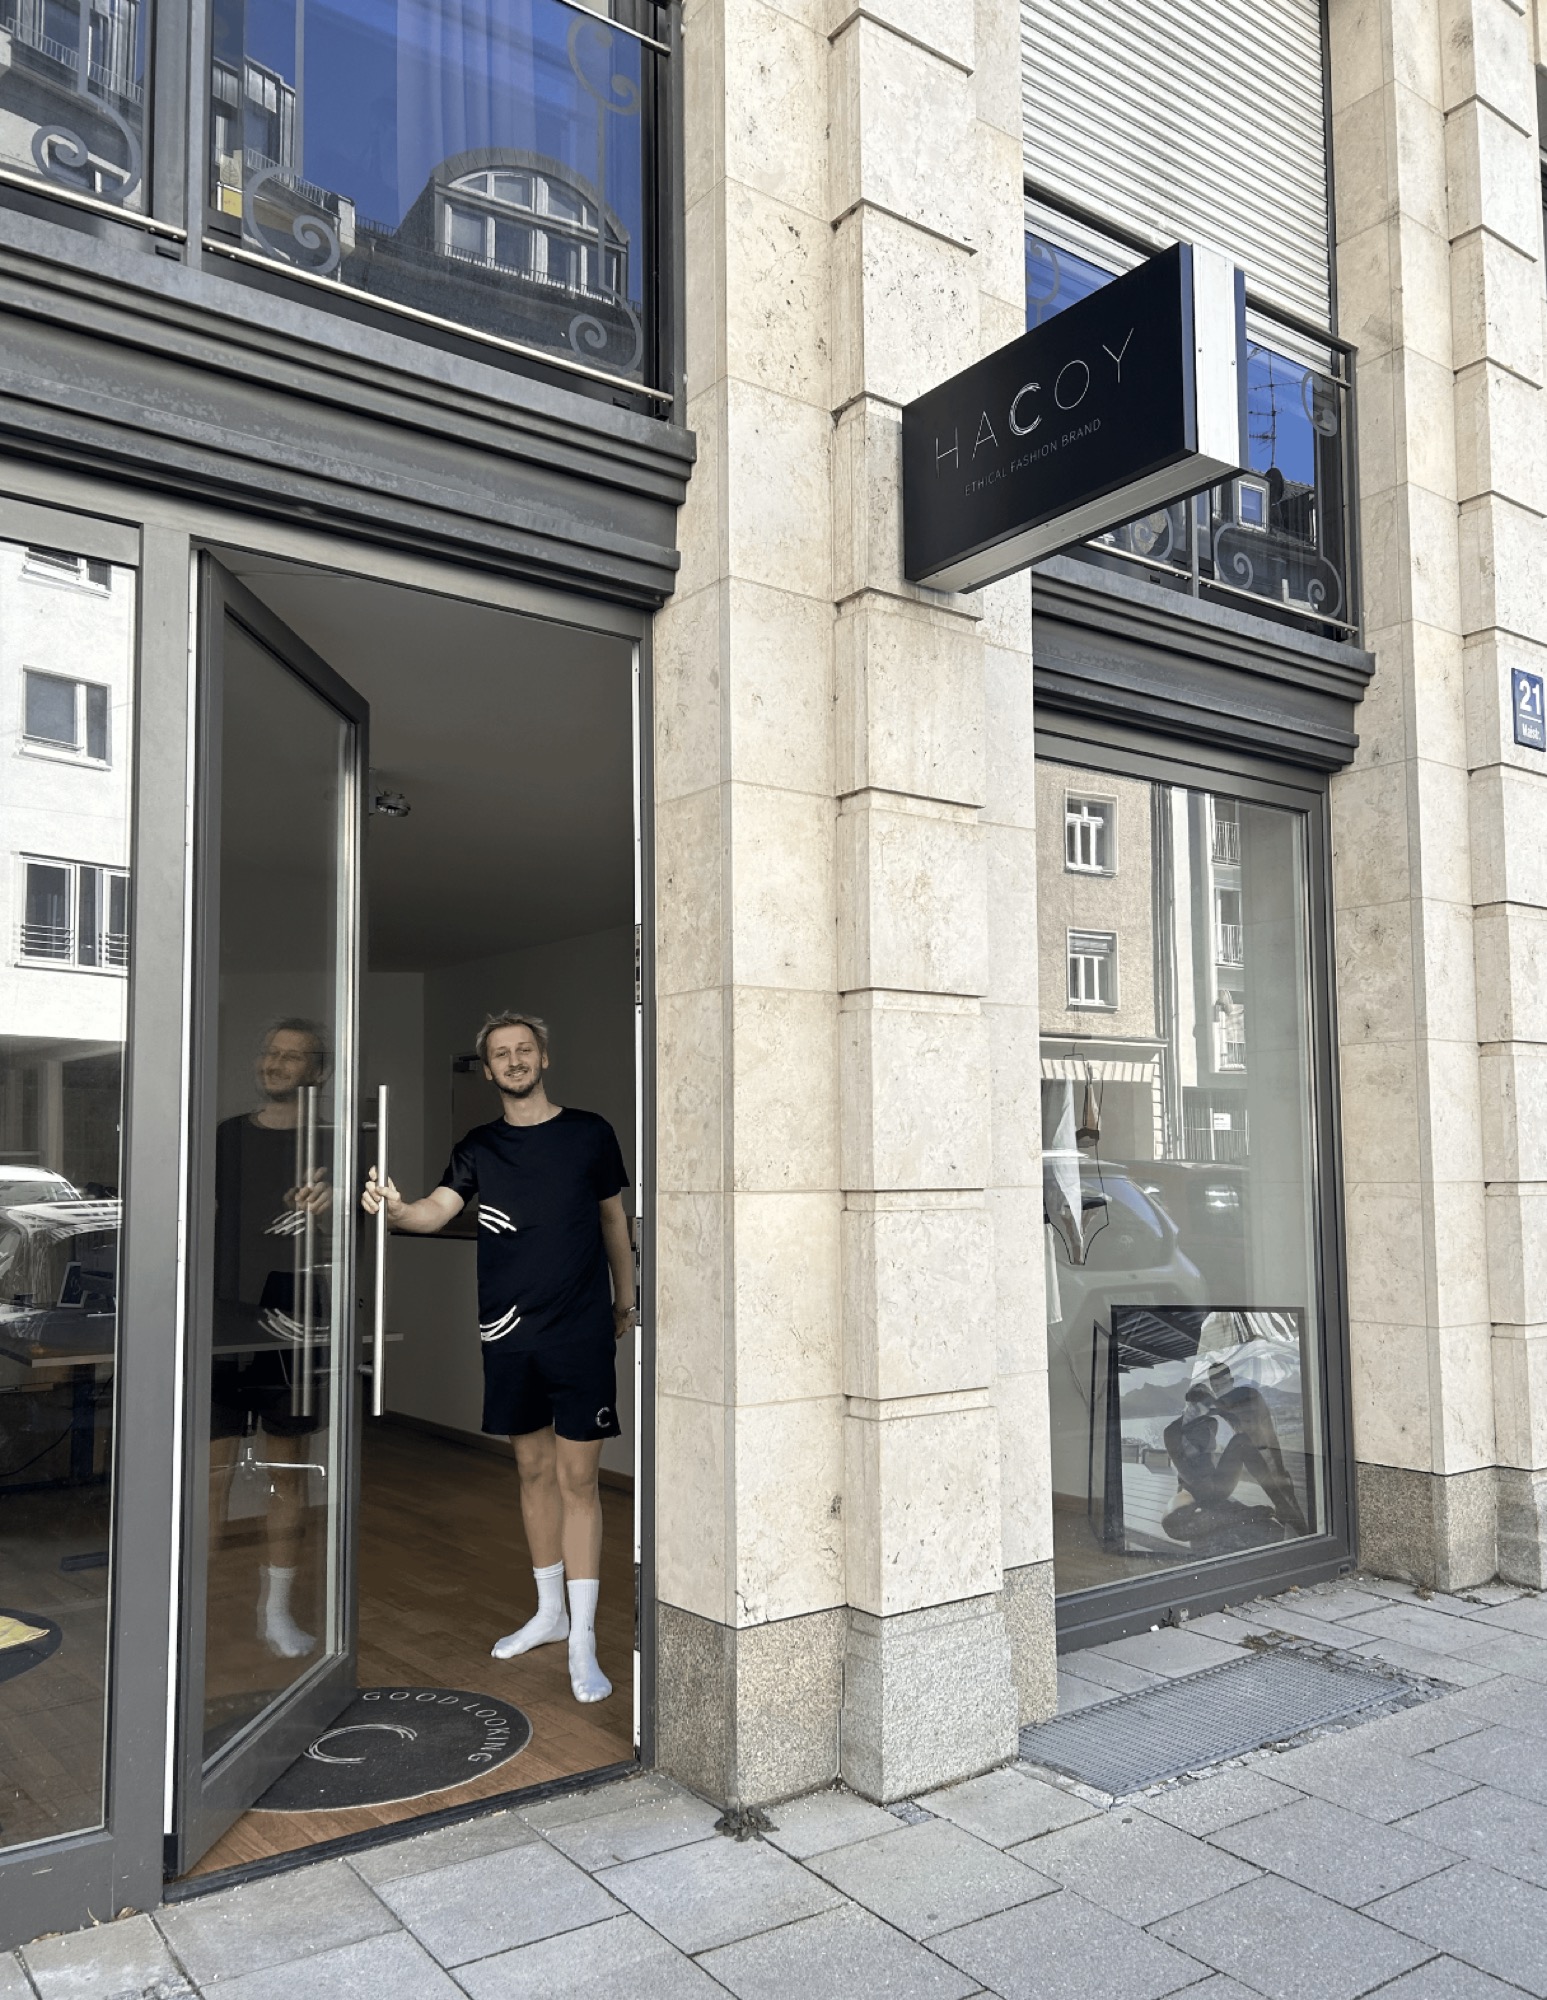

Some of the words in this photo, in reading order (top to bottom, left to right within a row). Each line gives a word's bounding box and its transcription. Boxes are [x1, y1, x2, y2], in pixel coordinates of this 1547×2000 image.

[935, 327, 1134, 478] HACOY
[965, 467, 1007, 497] ETHICAL
[1010, 440, 1057, 472] FASHION
[1061, 418, 1101, 447] BRAND
[1519, 679, 1541, 715] 21
[363, 1691, 459, 1705] GOOD
[462, 1702, 511, 1763] LOOKING
